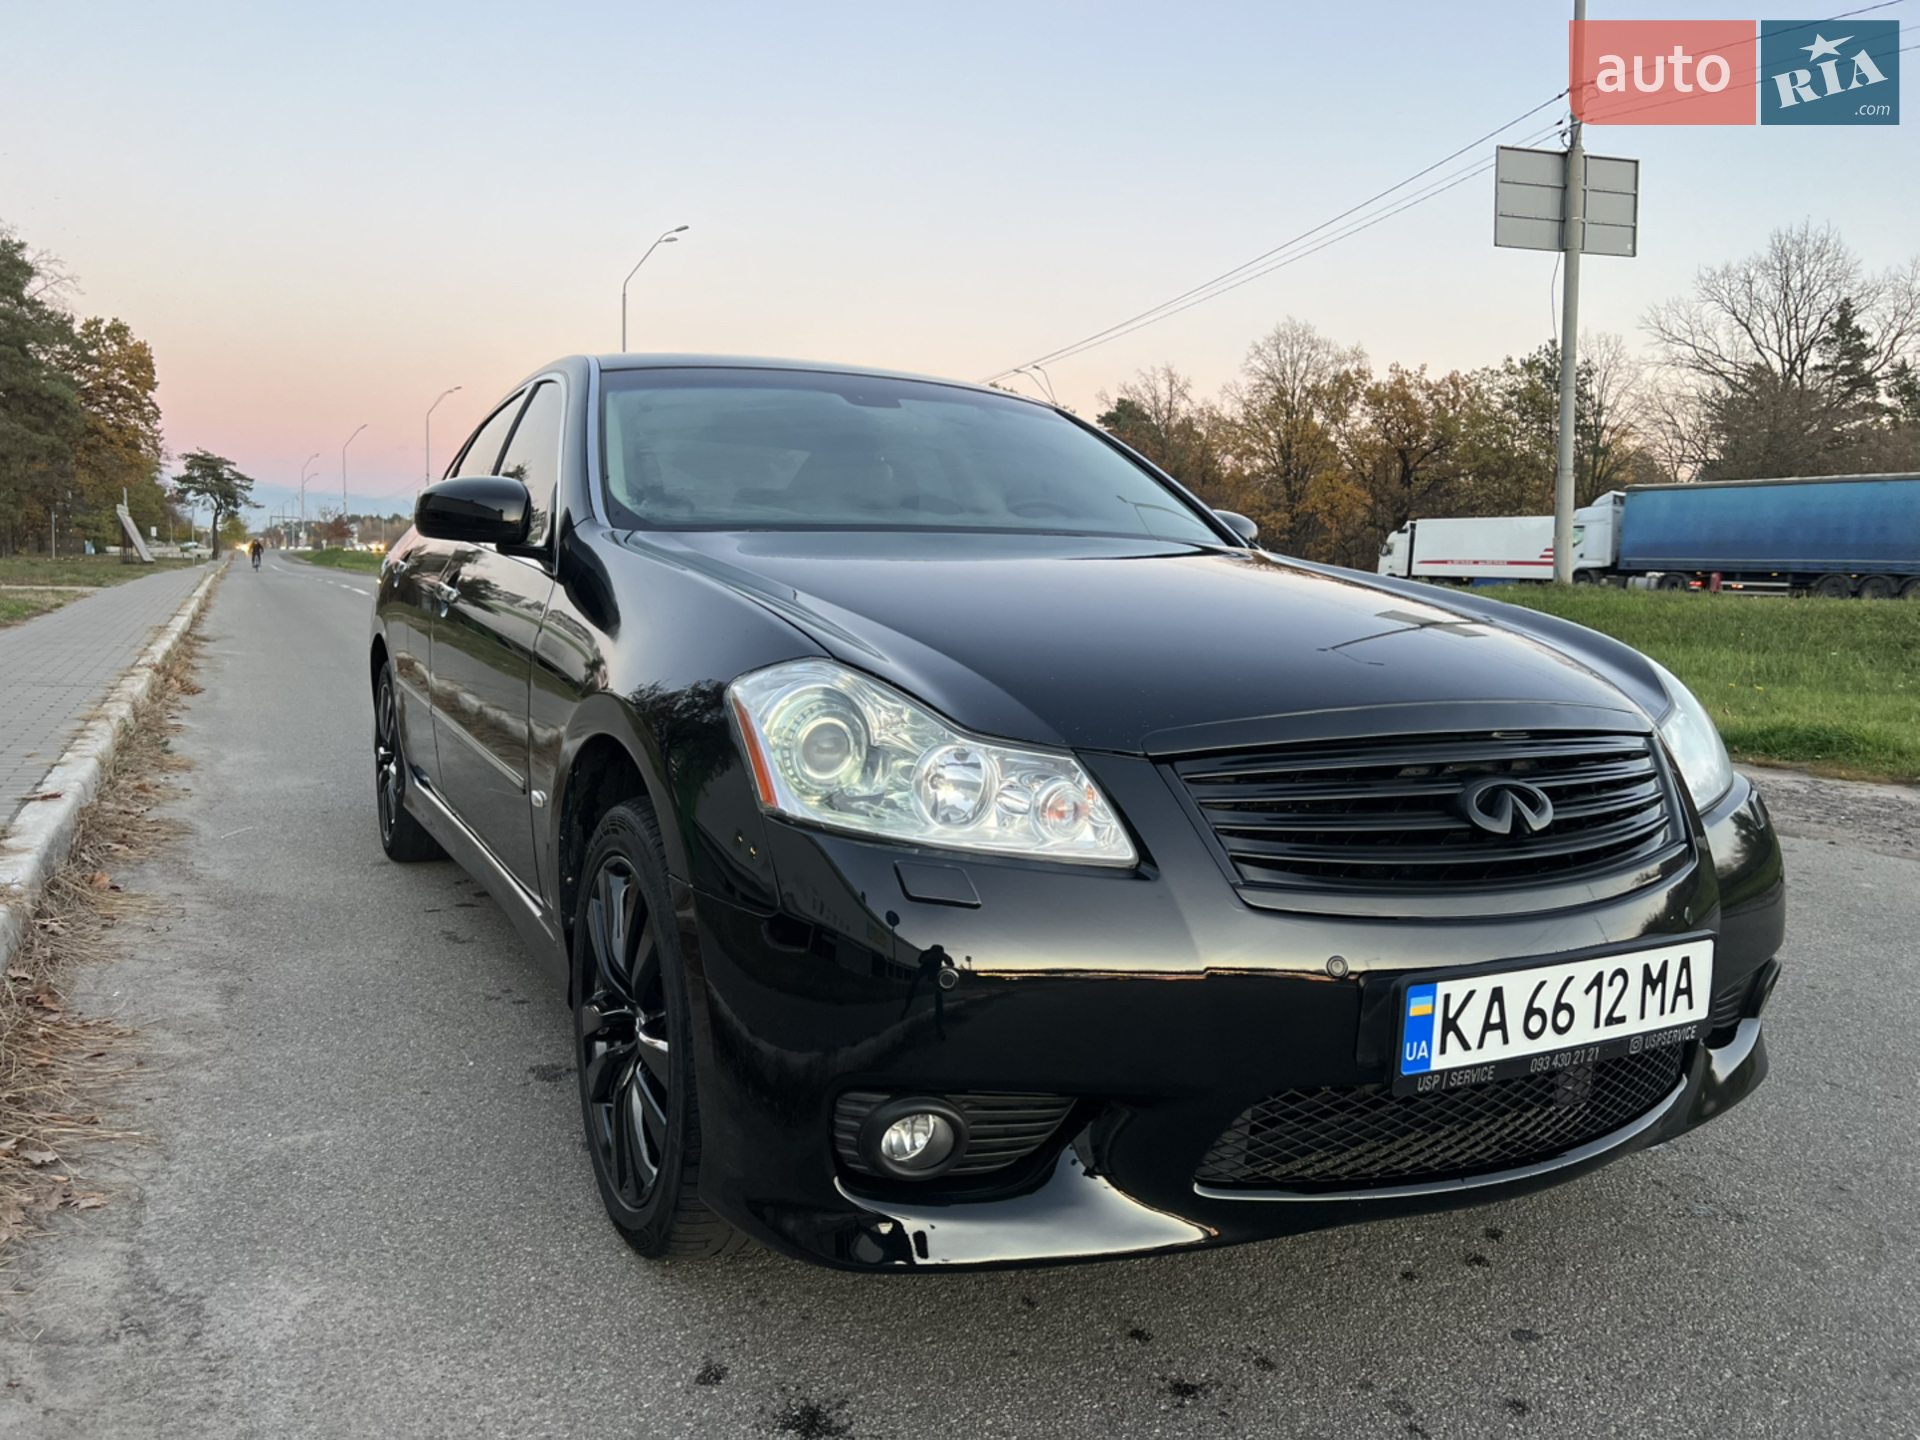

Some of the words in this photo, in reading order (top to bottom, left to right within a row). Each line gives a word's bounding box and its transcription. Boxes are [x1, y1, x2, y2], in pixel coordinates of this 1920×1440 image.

[1439, 986, 1510, 1056] KA
[1522, 967, 1629, 1041] 6612
[1639, 956, 1694, 1021] MA
[1405, 1040, 1429, 1061] UA
[1644, 1025, 1697, 1049] USPSERVICE
[1530, 1056, 1550, 1073] 093
[1552, 1052, 1572, 1068] 430
[1573, 1049, 1585, 1065] 21
[1587, 1046, 1599, 1062] 21
[1417, 1075, 1440, 1092] USP
[1450, 1065, 1496, 1087] SERVICE
